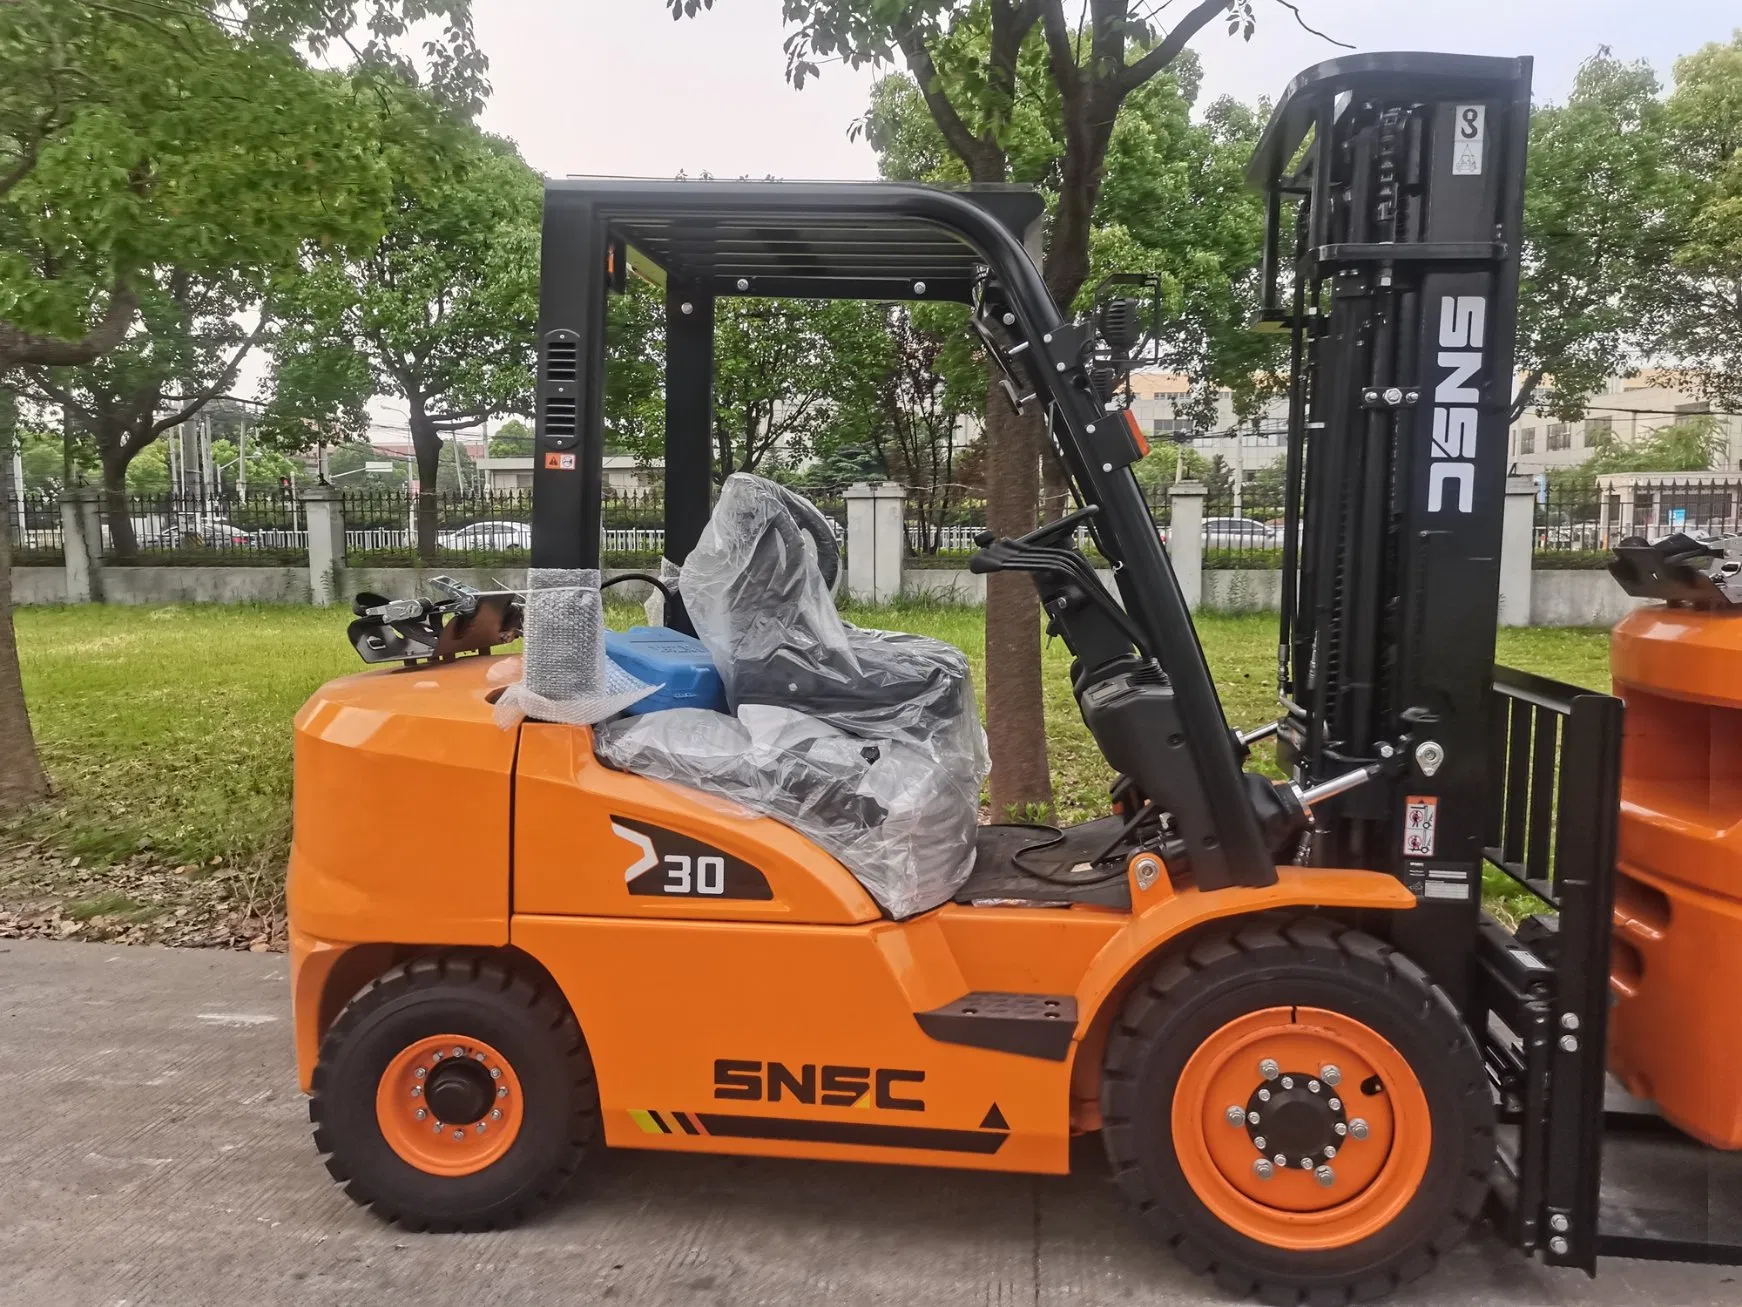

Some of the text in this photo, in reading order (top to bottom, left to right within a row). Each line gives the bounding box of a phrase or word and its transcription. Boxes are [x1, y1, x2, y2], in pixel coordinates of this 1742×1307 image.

[1428, 296, 1486, 513] SNSC
[664, 855, 725, 895] 30
[714, 1059, 926, 1112] SNSC
